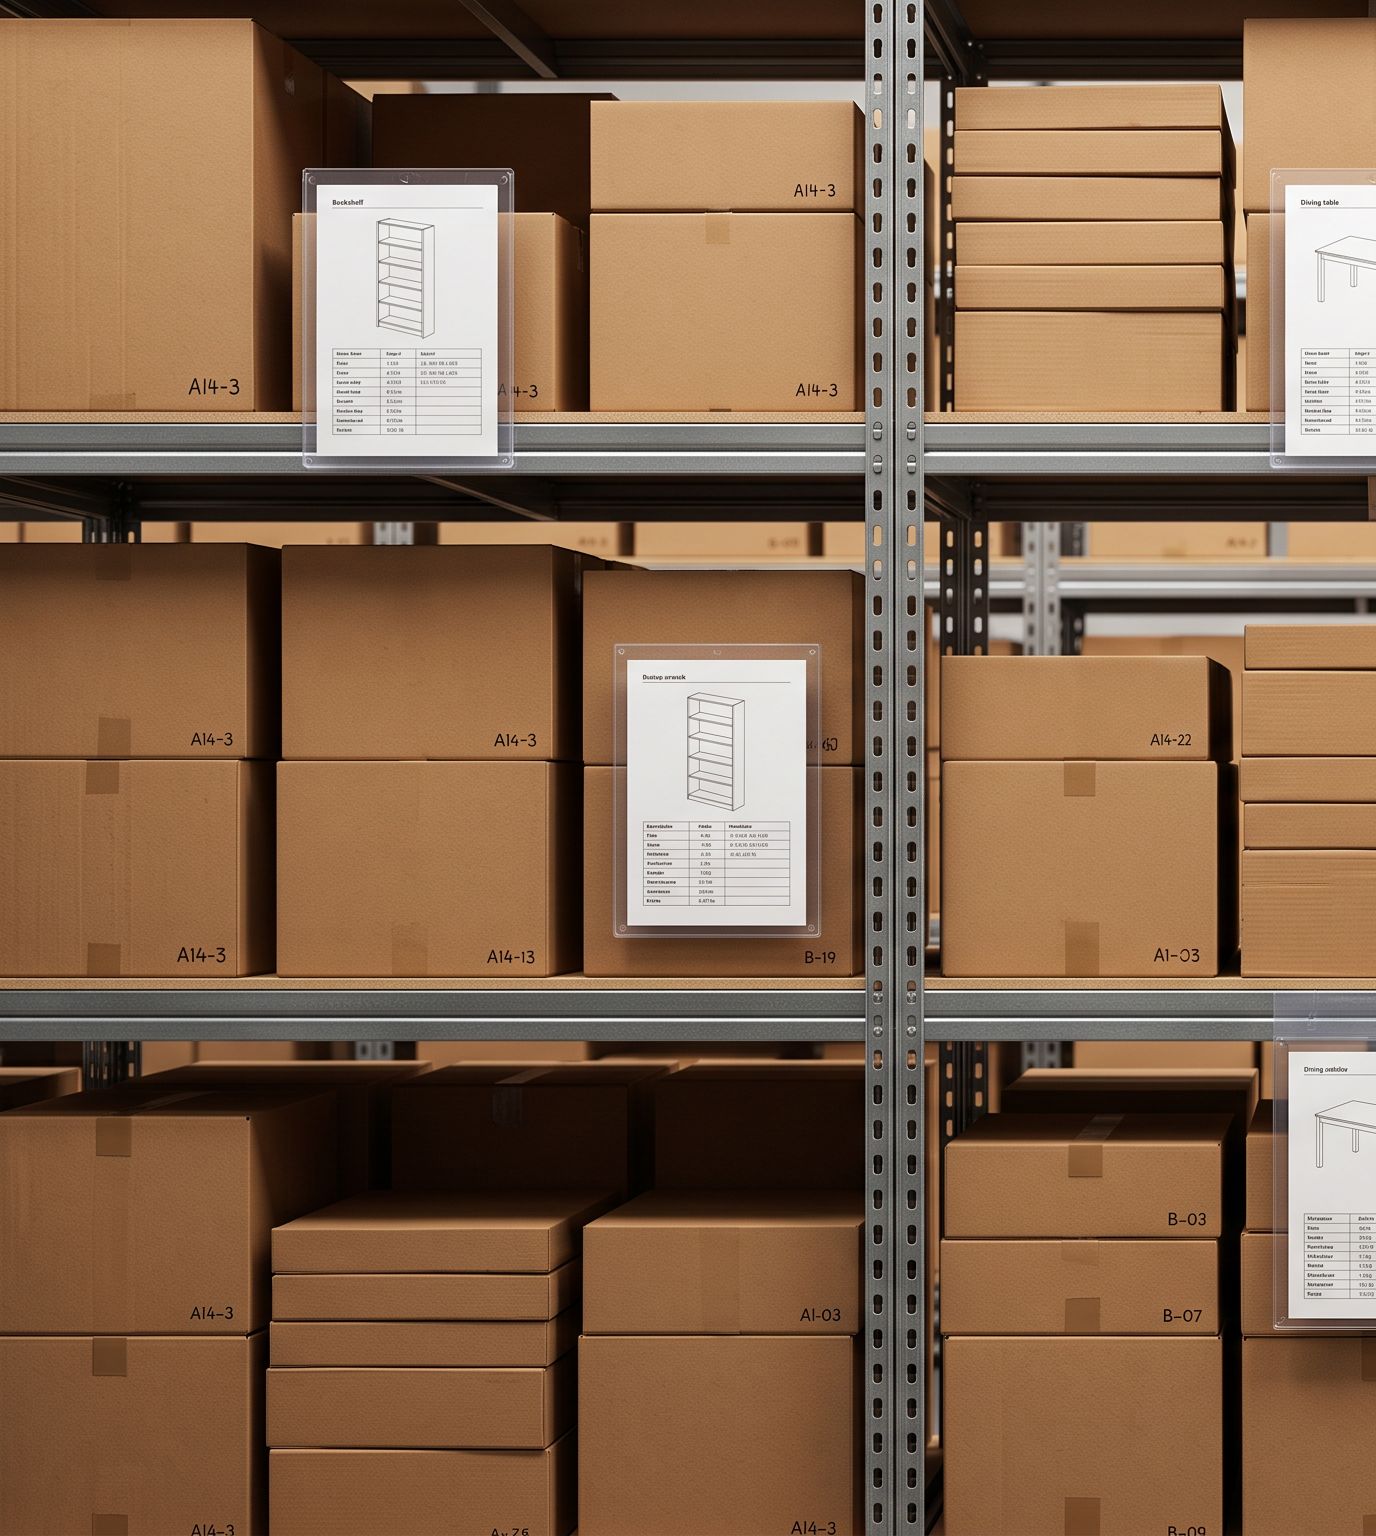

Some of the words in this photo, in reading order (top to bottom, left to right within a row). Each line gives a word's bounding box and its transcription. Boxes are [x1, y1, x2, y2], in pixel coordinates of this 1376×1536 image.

[794, 183, 836, 198] A14-3
[1300, 199, 1322, 207] Diving
[188, 378, 240, 396] A14-3
[796, 382, 839, 398] A14-3
[190, 732, 234, 747] A14-3
[494, 733, 537, 749] A14-3
[1150, 733, 1192, 747] A14-22
[177, 947, 226, 963] A14-3
[486, 950, 535, 965] A14-13
[804, 950, 836, 964] B-19
[1167, 1212, 1207, 1227] B-03
[189, 1305, 234, 1321] A14-3
[799, 1307, 841, 1322] A1-03
[1162, 1308, 1203, 1324] B-07
[790, 1520, 837, 1536] A14-3
